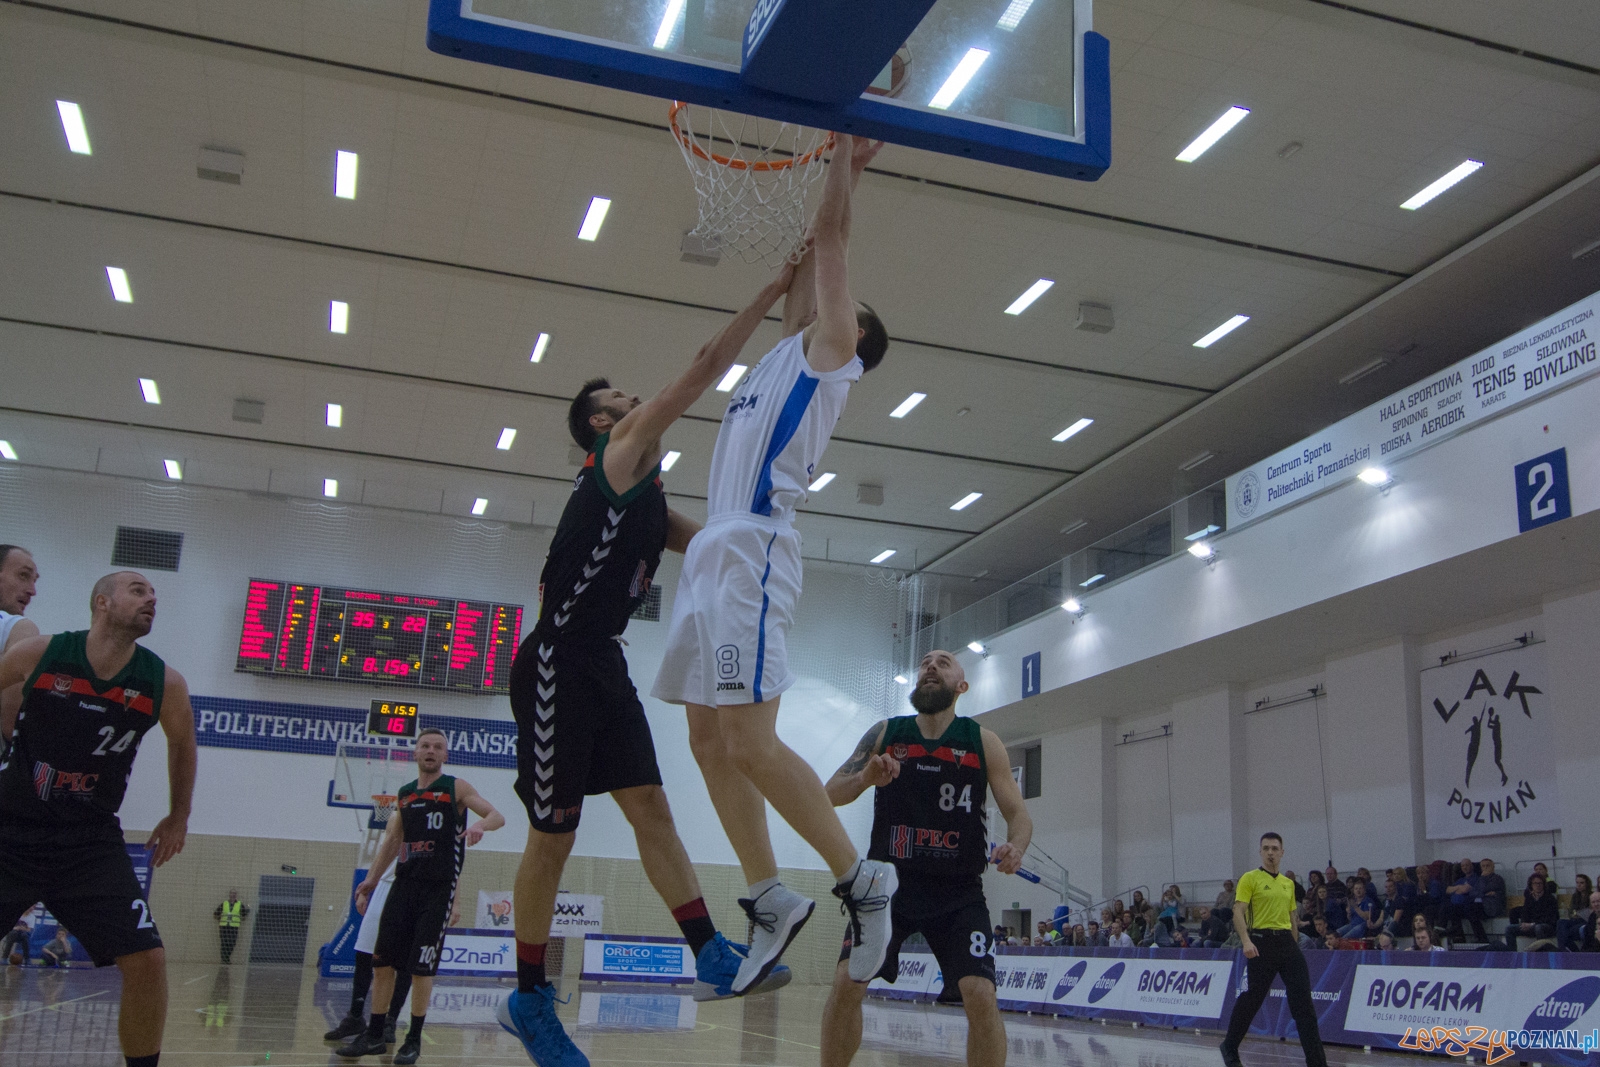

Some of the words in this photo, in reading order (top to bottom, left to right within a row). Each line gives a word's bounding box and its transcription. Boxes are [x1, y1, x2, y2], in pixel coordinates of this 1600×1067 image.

[1529, 309, 1594, 346] LEKKOATLETYCZNA
[1536, 329, 1587, 362] SIŁOWNIA
[1472, 356, 1495, 377] JUDO
[1524, 342, 1597, 391] BOWLING
[1473, 364, 1516, 398] TENIS
[1380, 400, 1406, 422] HALA
[1408, 371, 1463, 409] SPORTOWA
[1437, 391, 1462, 410] SZACHY
[1481, 391, 1507, 408] KARATE
[1381, 432, 1412, 455] BOISKA
[1421, 406, 1465, 437] AEROBIK
[1267, 457, 1301, 480] Centrum
[1304, 442, 1332, 464] Sportu
[1267, 470, 1314, 502] Politechniki
[1318, 444, 1370, 479] Poznańskiej
[1528, 463, 1557, 520] 2
[351, 611, 376, 629] 35
[382, 621, 390, 629] 3
[402, 615, 427, 633] 22
[333, 634, 341, 643] 2
[341, 655, 348, 664] 2
[413, 661, 421, 669] 2
[716, 644, 740, 679] 8
[717, 681, 745, 691] joma
[1026, 658, 1034, 693] 1
[1433, 668, 1544, 724] VAK
[387, 718, 405, 733] 16
[91, 725, 137, 756] 24
[916, 762, 942, 773] hummel
[53, 771, 99, 792] PEC
[938, 783, 972, 813] 84
[1447, 780, 1536, 823] POZNAŃ
[426, 811, 443, 830] 10
[915, 828, 960, 849] PEC
[131, 899, 155, 929] 2
[418, 945, 435, 963] 10
[898, 960, 927, 978] OFARM
[1011, 971, 1026, 989] PBG
[1031, 972, 1047, 990] PBG
[1059, 973, 1079, 987] atrem
[1095, 976, 1116, 990] atrem
[1137, 969, 1213, 996] BIOFARM
[1367, 978, 1487, 1014] BIOFARM
[1536, 996, 1584, 1019] atrem
[1372, 1012, 1396, 1022] POLSKI
[1399, 1014, 1440, 1025] PRODUCENT
[1443, 1017, 1470, 1027] LEKÓW
